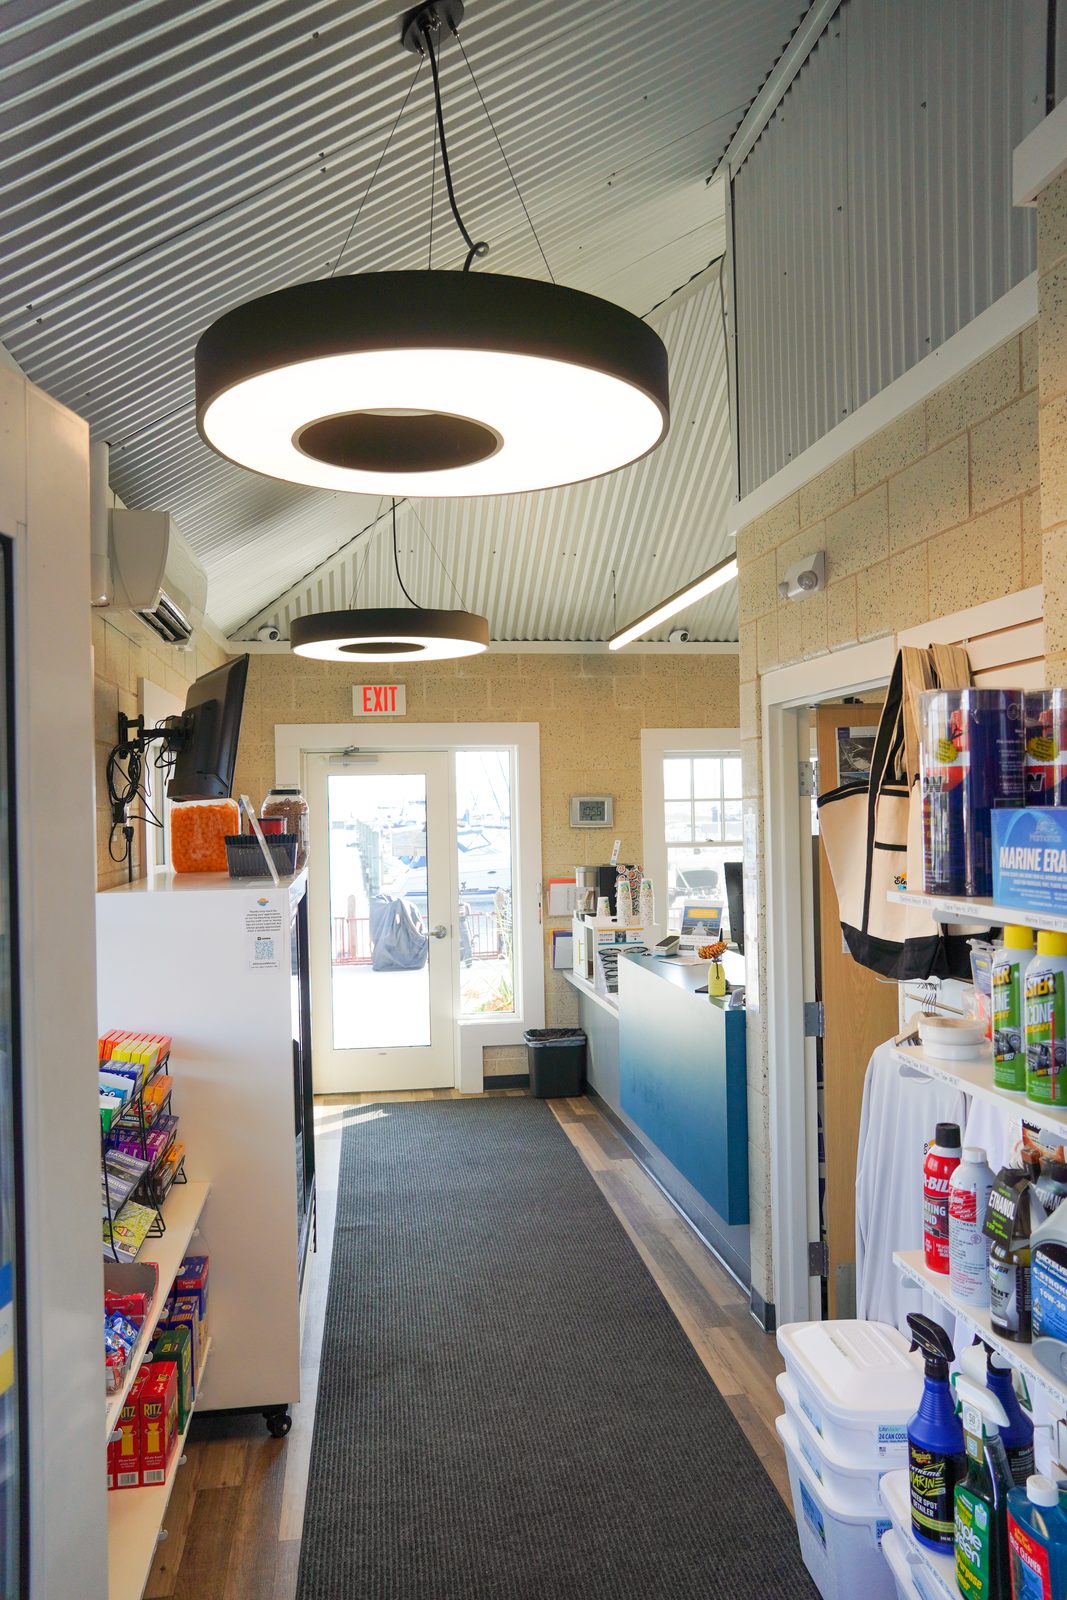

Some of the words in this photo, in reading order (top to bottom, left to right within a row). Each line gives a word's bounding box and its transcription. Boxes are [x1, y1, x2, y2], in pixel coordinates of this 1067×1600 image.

[363, 686, 398, 712] EXIT
[1000, 846, 1042, 872] MARINE
[1043, 848, 1067, 873] ERA
[989, 1190, 1016, 1220] ETHANOL
[144, 1403, 162, 1416] RITZ
[923, 1499, 938, 1510] SPOT
